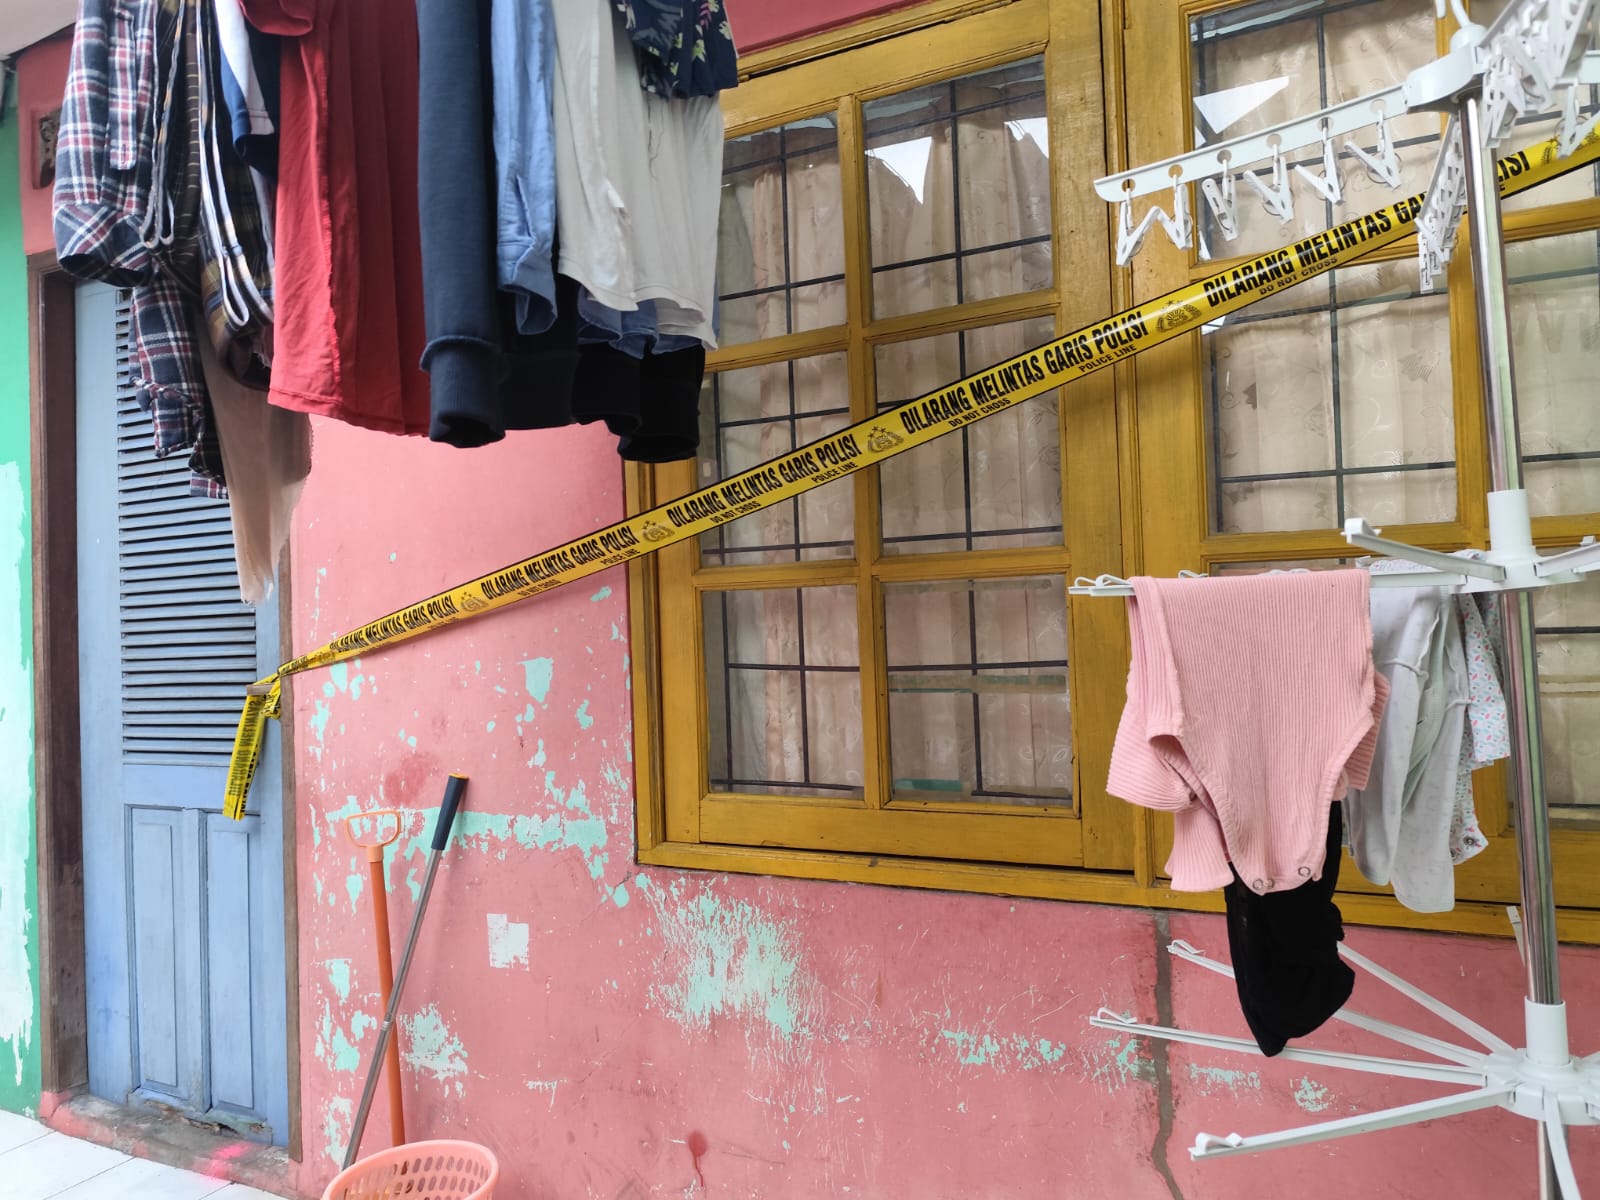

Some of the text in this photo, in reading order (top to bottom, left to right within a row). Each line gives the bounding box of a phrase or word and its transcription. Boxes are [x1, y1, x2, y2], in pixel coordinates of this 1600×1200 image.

[1203, 250, 1295, 308] DILARANG
[1294, 209, 1392, 263] MELINTAS
[1259, 257, 1338, 295] DO NOT CROSS
[899, 311, 1149, 434] DILARANG MELINTAS GARIS POLISI
[1079, 344, 1137, 373] POLICE LINE
[947, 398, 1011, 428] DO NOT CROSS
[667, 433, 862, 528] DILARANG MELINTAS GARIS POLISI
[811, 461, 858, 484] POLICE LINE
[710, 500, 762, 524] DO NOT CROSS
[480, 525, 640, 600] DILARANG MELINTAS GARIS POLISI
[365, 616, 407, 642] MELINTAS
[402, 605, 432, 630] GARIS
[427, 594, 459, 619] POLISI
